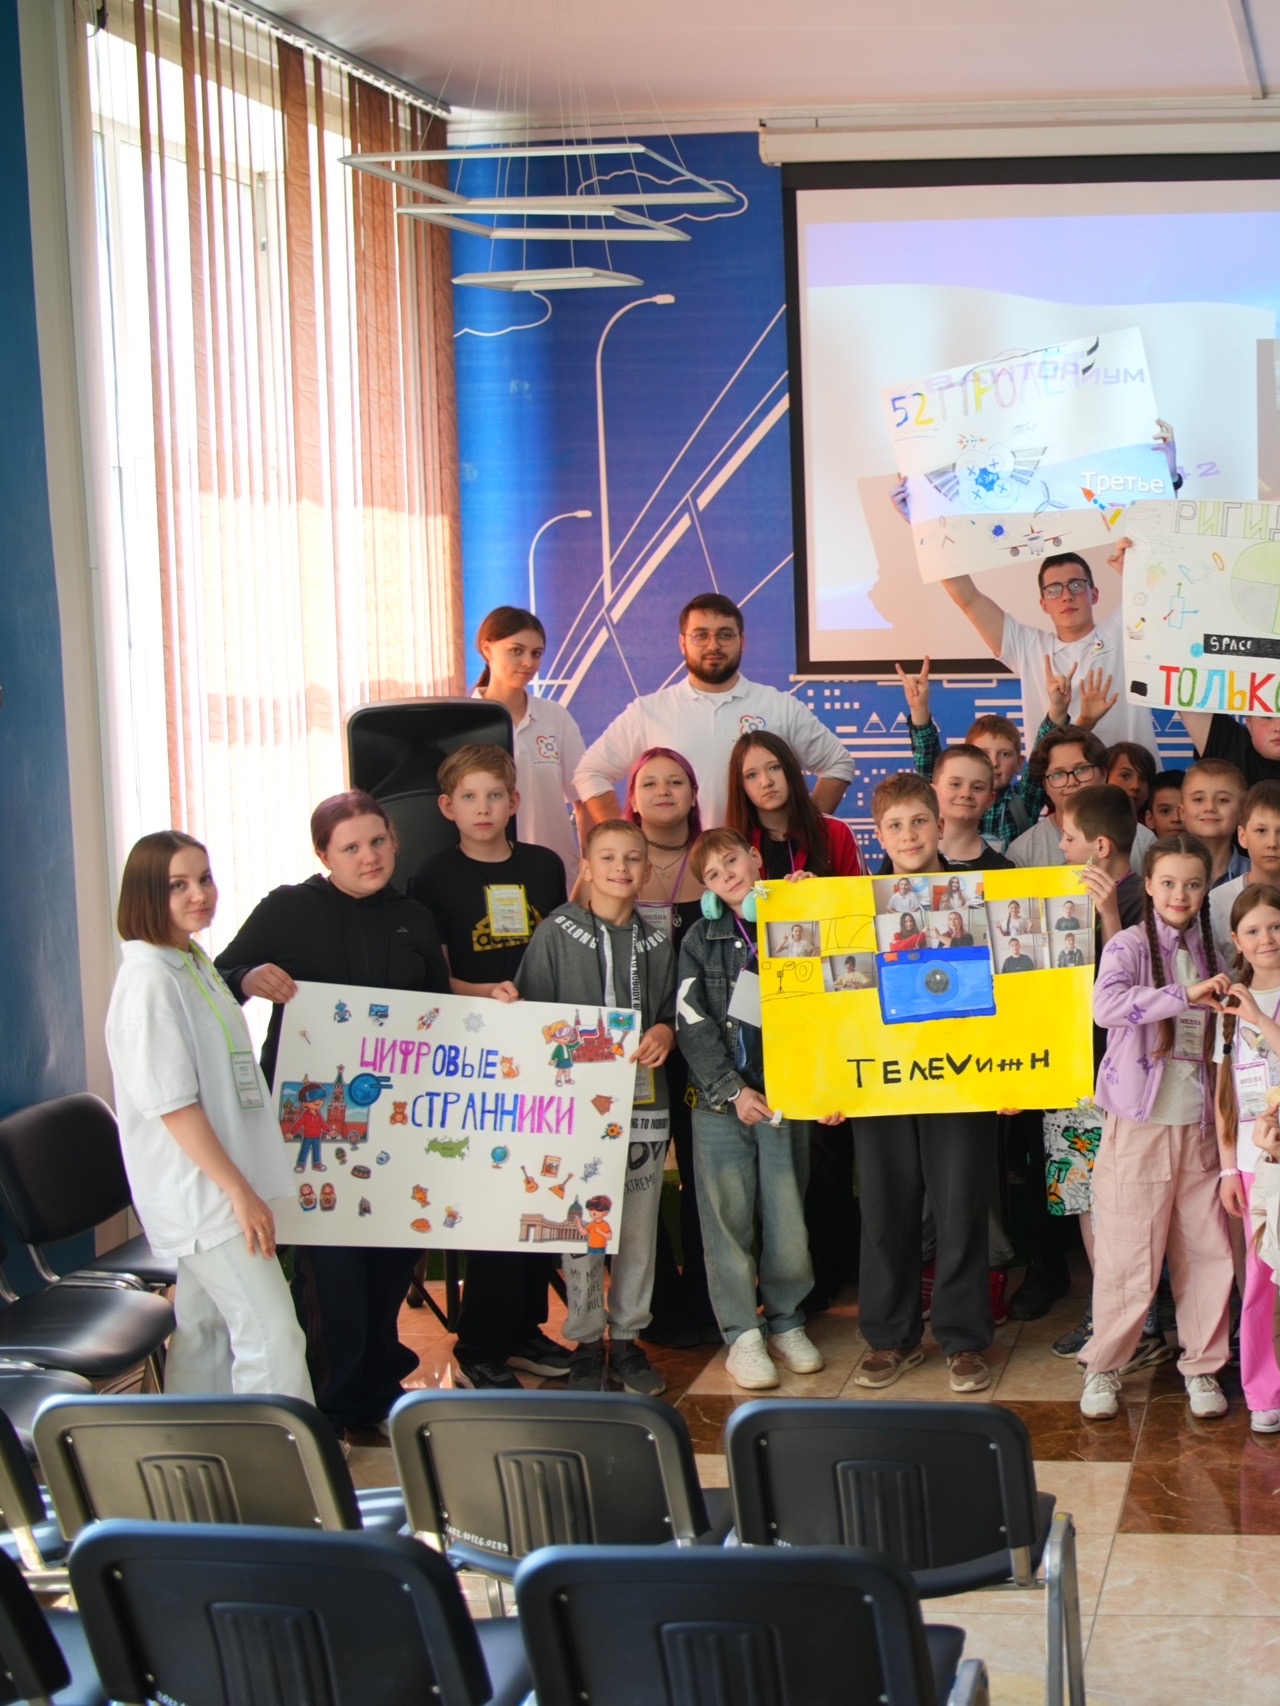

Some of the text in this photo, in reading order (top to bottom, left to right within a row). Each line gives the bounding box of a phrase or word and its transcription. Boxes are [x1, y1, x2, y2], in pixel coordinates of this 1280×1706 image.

[890, 391, 935, 428] 52
[1079, 471, 1165, 496] Третье
[1210, 636, 1252, 651] SPACE
[359, 1037, 500, 1080] ЦИФРОВЫЕ
[411, 1091, 576, 1135] СТРАННИКИ
